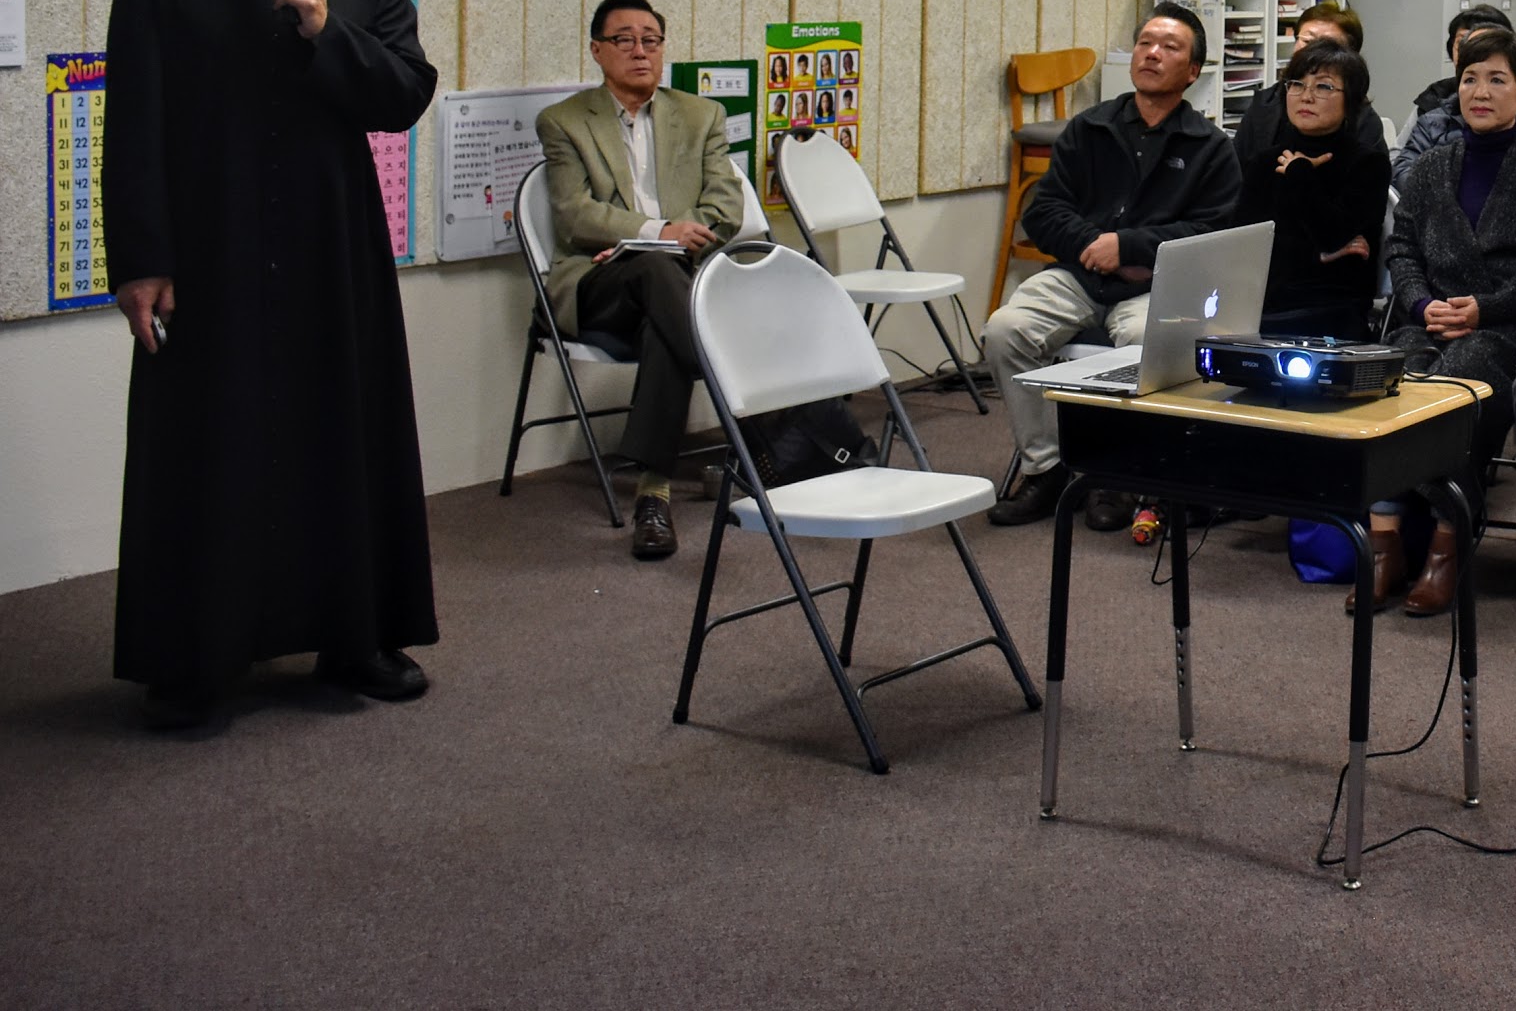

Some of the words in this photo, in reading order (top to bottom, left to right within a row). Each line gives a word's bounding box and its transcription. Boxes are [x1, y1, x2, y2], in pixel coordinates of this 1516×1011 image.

[792, 25, 840, 38] Emotions
[77, 97, 84, 107] 2
[95, 96, 101, 106] 3
[59, 118, 68, 128] 11
[76, 117, 86, 128] 12
[93, 116, 103, 126] 13
[58, 139, 69, 149] 21
[74, 138, 88, 148] 22
[59, 160, 69, 170] 31
[75, 158, 88, 168] 32
[59, 180, 69, 190] 41
[75, 178, 88, 189] 42
[92, 177, 101, 187] 4
[60, 201, 69, 211] 51
[76, 199, 88, 210] 52
[59, 221, 69, 232] 61
[76, 219, 88, 230] 62
[60, 242, 69, 252] 71
[76, 239, 88, 250] 72
[60, 262, 69, 272] 81
[76, 260, 88, 270] 82
[93, 258, 106, 268] 83
[60, 282, 69, 293] 91
[76, 280, 88, 291] 92
[93, 278, 106, 288] 93
[1242, 360, 1259, 368] EPSON
